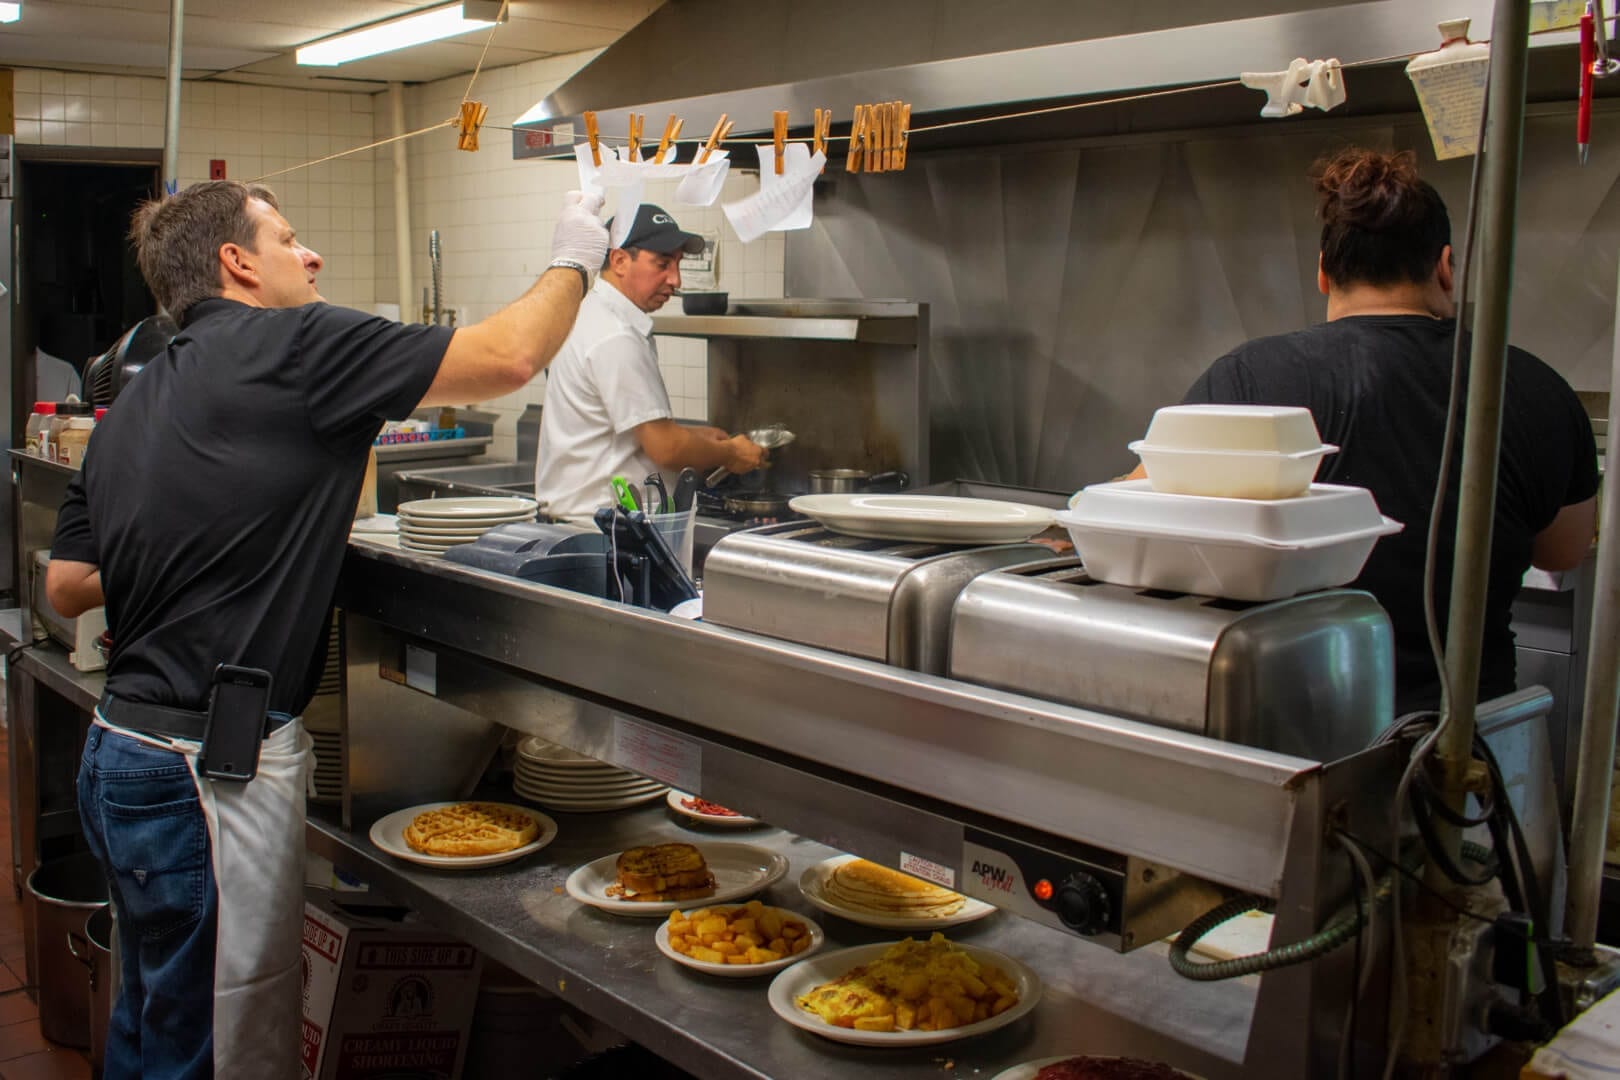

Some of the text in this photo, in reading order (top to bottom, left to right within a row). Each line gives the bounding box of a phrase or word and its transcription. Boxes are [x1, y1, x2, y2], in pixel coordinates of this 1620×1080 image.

[971, 860, 1006, 882] APW
[318, 931, 328, 949] UP
[385, 947, 454, 964] THIS SIDE UP
[344, 1038, 457, 1054] CREAMY LIQUID
[352, 1055, 444, 1069] SHORTENING
